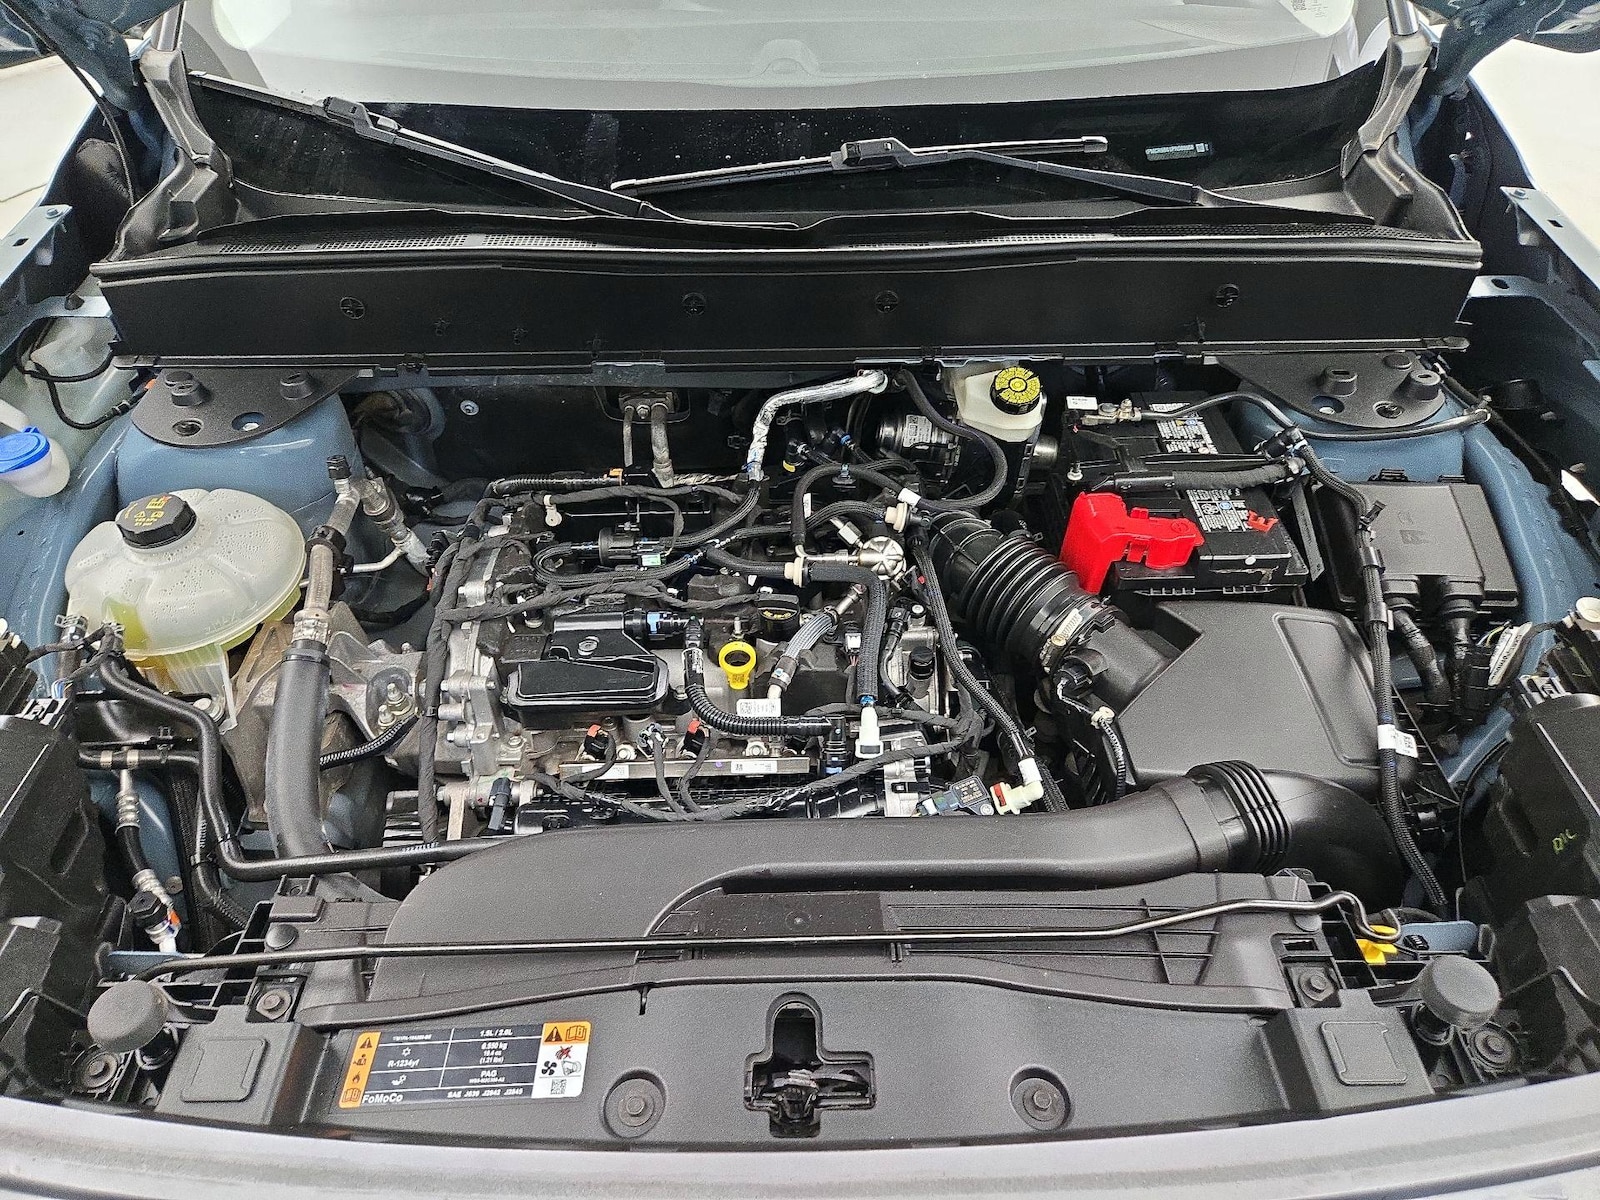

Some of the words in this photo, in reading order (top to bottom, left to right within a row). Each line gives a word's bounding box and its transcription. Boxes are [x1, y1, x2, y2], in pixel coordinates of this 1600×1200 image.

[499, 1042, 509, 1051] kg
[387, 1059, 420, 1068] R-1234yf
[361, 1092, 403, 1104] FoMoCo
[447, 1090, 462, 1098] SAE
